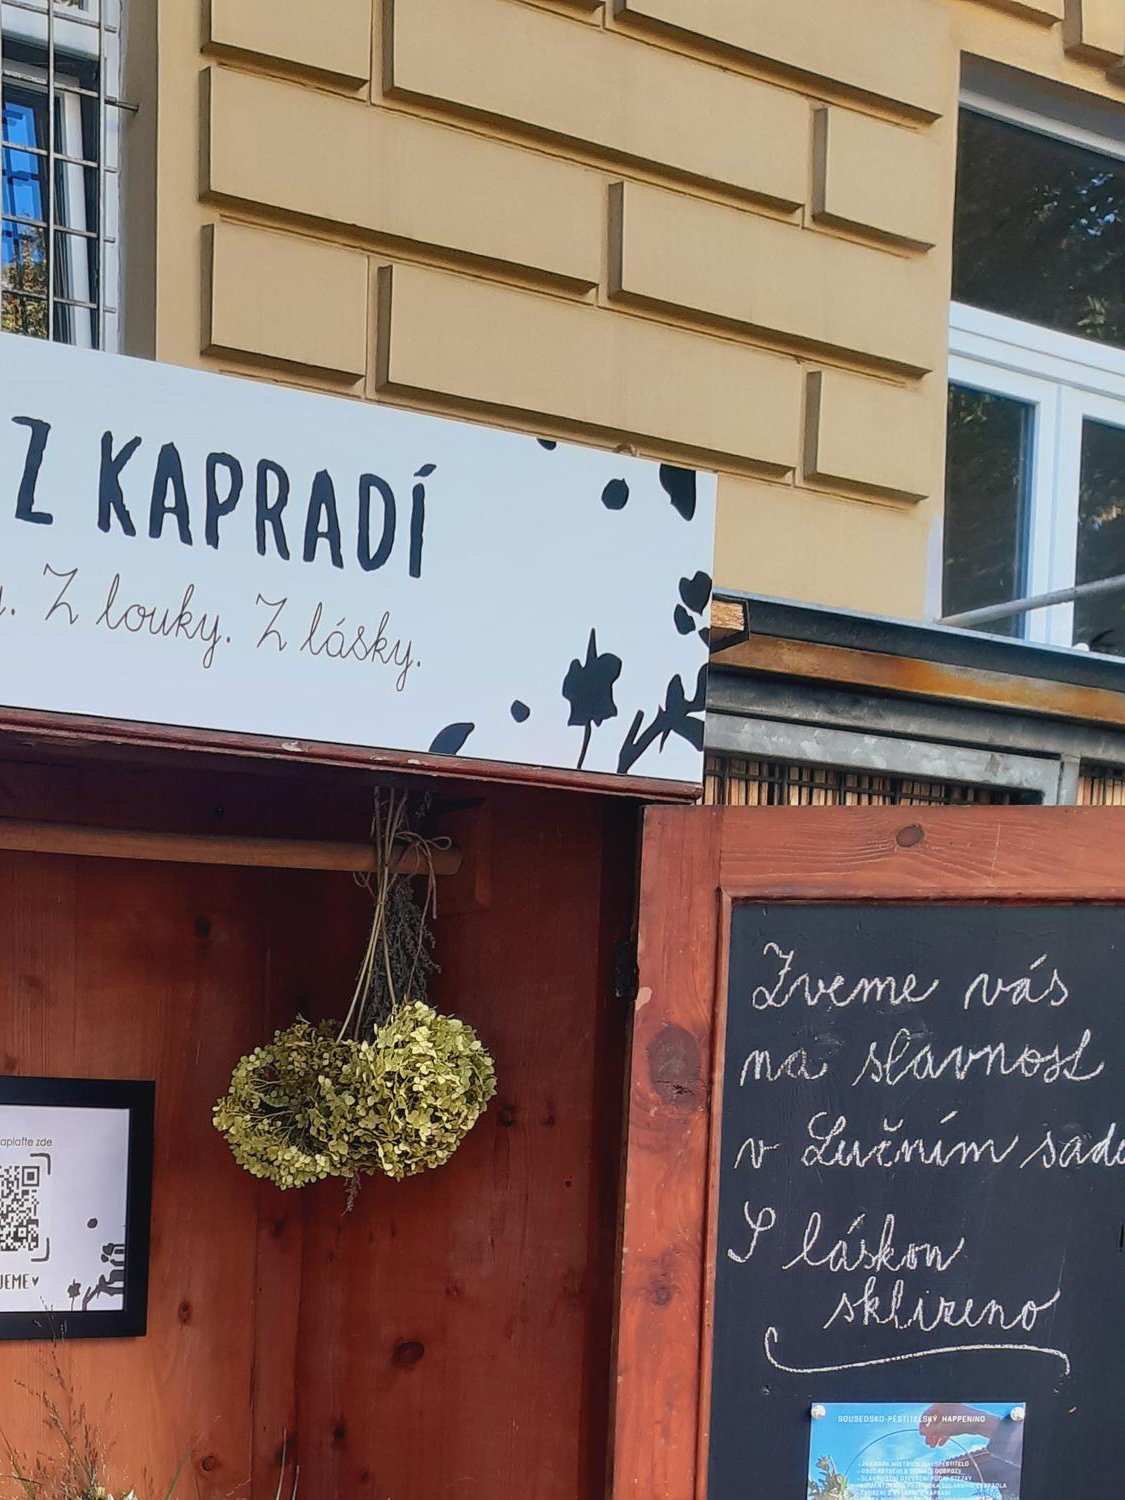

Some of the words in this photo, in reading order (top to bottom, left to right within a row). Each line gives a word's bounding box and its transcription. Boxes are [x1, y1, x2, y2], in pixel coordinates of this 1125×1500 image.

[12, 415, 53, 524] Z
[99, 430, 438, 578] KAPRADÍ
[43, 563, 79, 625] Z
[97, 583, 232, 669] louky.
[255, 593, 288, 652] Z
[301, 600, 422, 692] lásky.
[752, 942, 940, 1010] Zveme
[964, 953, 1069, 1010] vás
[739, 1047, 828, 1087] na
[851, 1028, 1105, 1087] slavnost
[35, 1137, 53, 1147] zde
